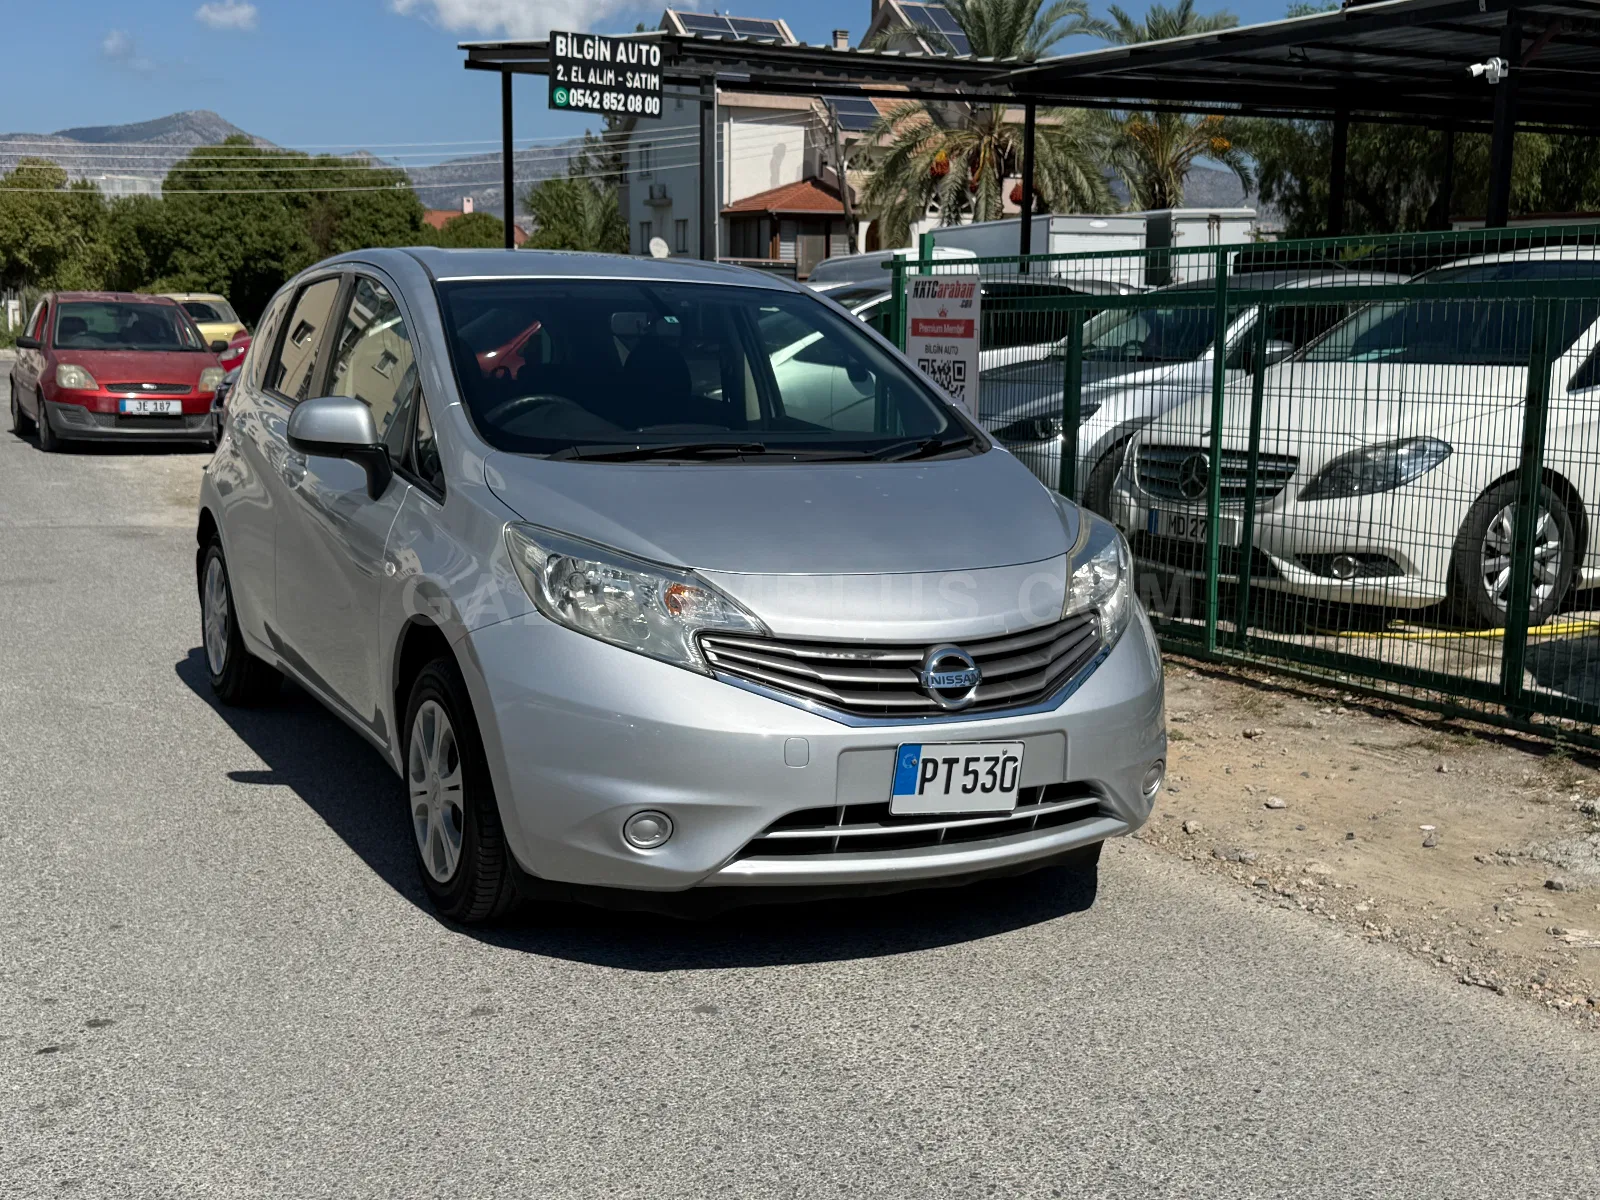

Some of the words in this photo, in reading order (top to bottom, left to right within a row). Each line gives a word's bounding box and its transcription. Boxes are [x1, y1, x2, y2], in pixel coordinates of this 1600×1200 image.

[555, 32, 611, 62] BİLGİN
[616, 42, 661, 67] AUTO
[556, 64, 568, 81] 2.
[570, 65, 585, 83] EL
[588, 67, 615, 86] ALIM
[625, 71, 659, 90] SATIM
[569, 88, 600, 109] 0542
[602, 92, 625, 111] 852
[627, 94, 642, 113] 08
[644, 96, 660, 115] 00
[919, 323, 943, 333] Premium
[944, 344, 959, 355] AUTO
[136, 401, 149, 411] JE
[1189, 518, 1209, 539] 27
[931, 672, 981, 686] NISSAN
